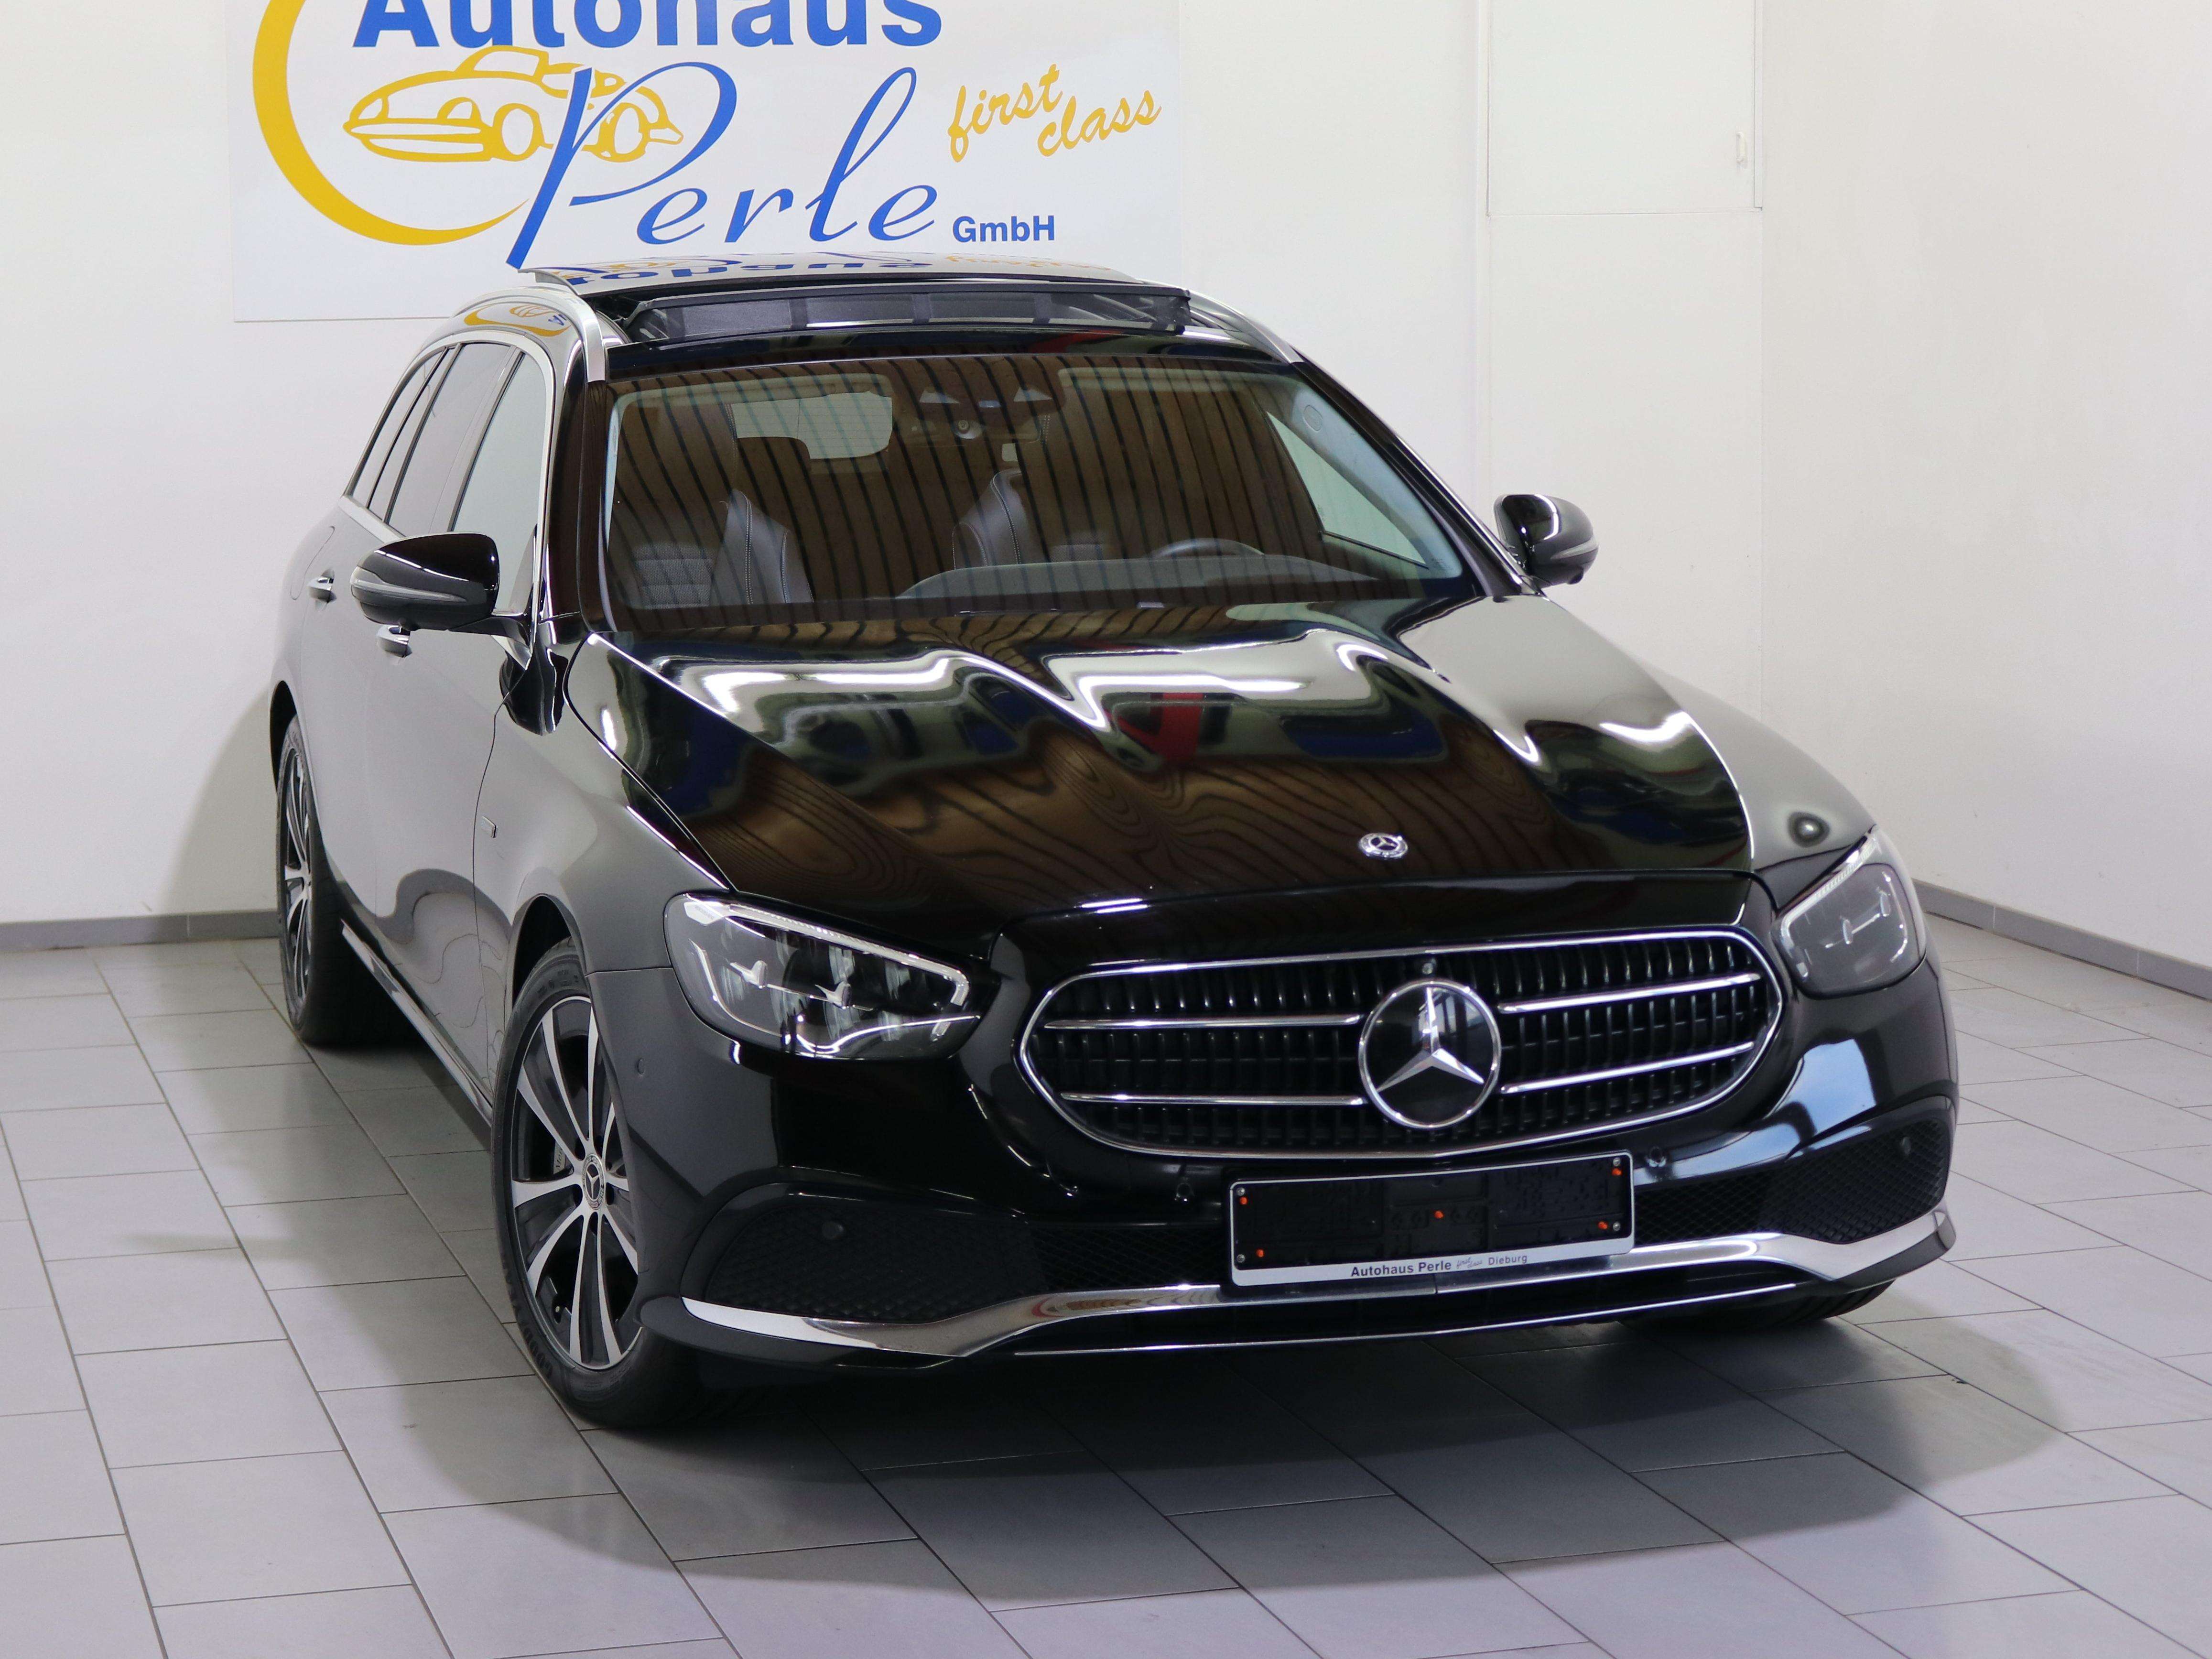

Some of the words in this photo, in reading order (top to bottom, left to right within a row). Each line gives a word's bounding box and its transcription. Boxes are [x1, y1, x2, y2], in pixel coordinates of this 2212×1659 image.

[353, 0, 942, 48] Autohaus
[948, 64, 1063, 163] first
[1038, 90, 1162, 157] class
[506, 62, 938, 269] Perle
[953, 216, 1055, 242] GmbH
[1351, 1265, 1414, 1277] Autohaus
[1419, 1261, 1452, 1272] Perle
[1488, 1255, 1528, 1266] Dieburg
